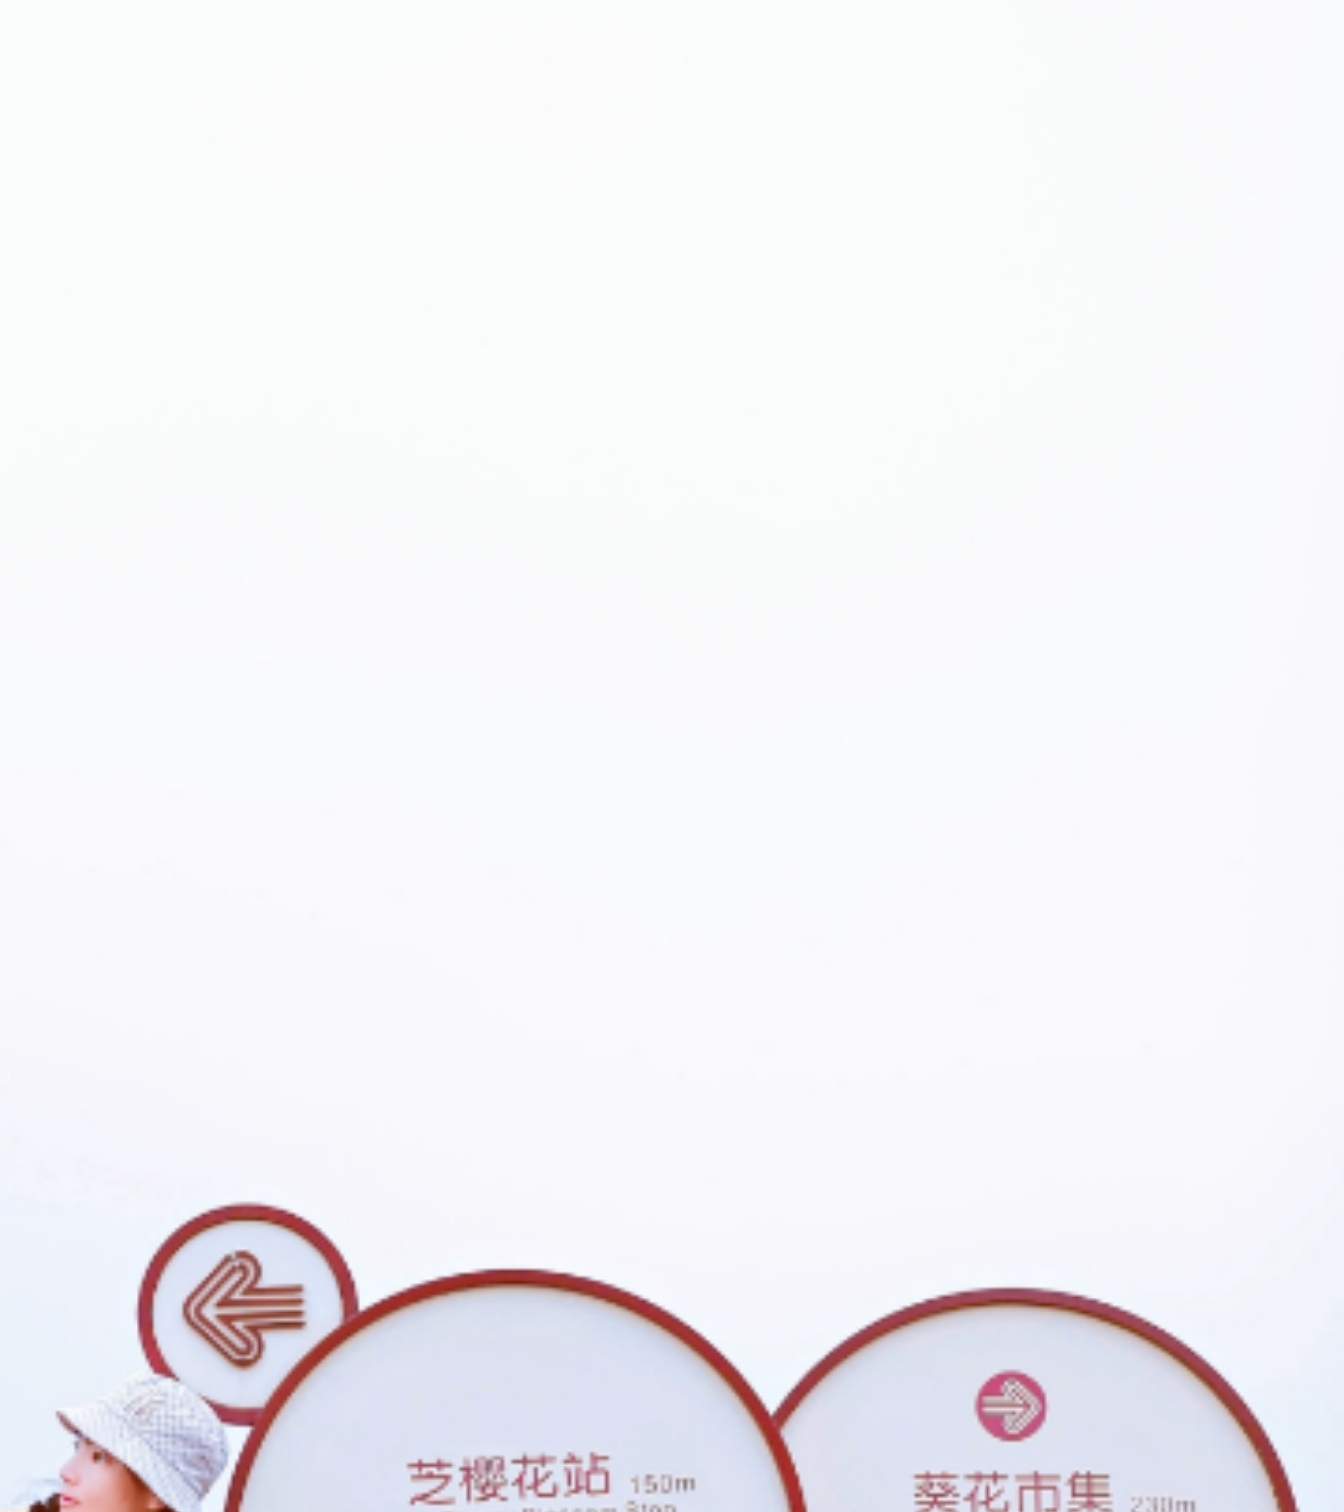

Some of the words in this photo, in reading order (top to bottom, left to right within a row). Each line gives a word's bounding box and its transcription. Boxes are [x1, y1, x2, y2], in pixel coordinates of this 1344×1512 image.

[407, 1451, 611, 1506] 芝樱花站
[630, 1474, 696, 1496] 150m
